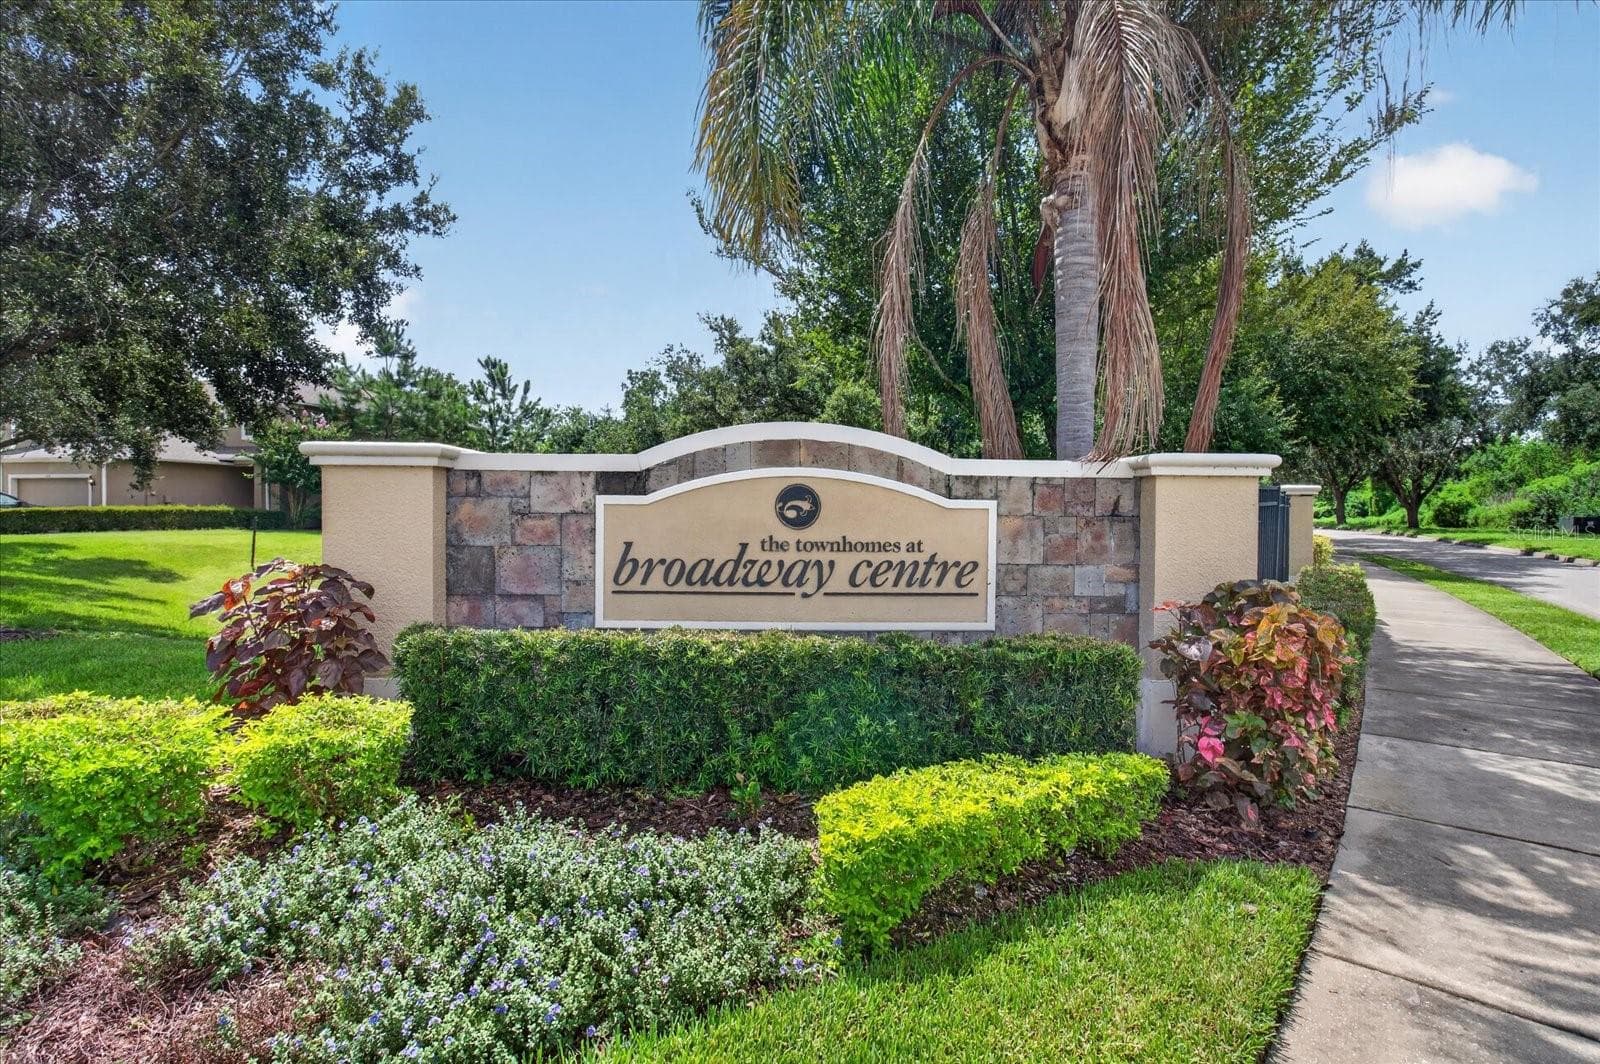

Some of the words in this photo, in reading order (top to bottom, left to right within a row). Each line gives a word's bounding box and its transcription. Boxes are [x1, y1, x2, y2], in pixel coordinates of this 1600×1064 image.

[760, 535, 789, 553] the
[795, 536, 901, 553] townhomes
[906, 539, 924, 553] at
[613, 541, 835, 598] broadway
[848, 552, 979, 588] centre
